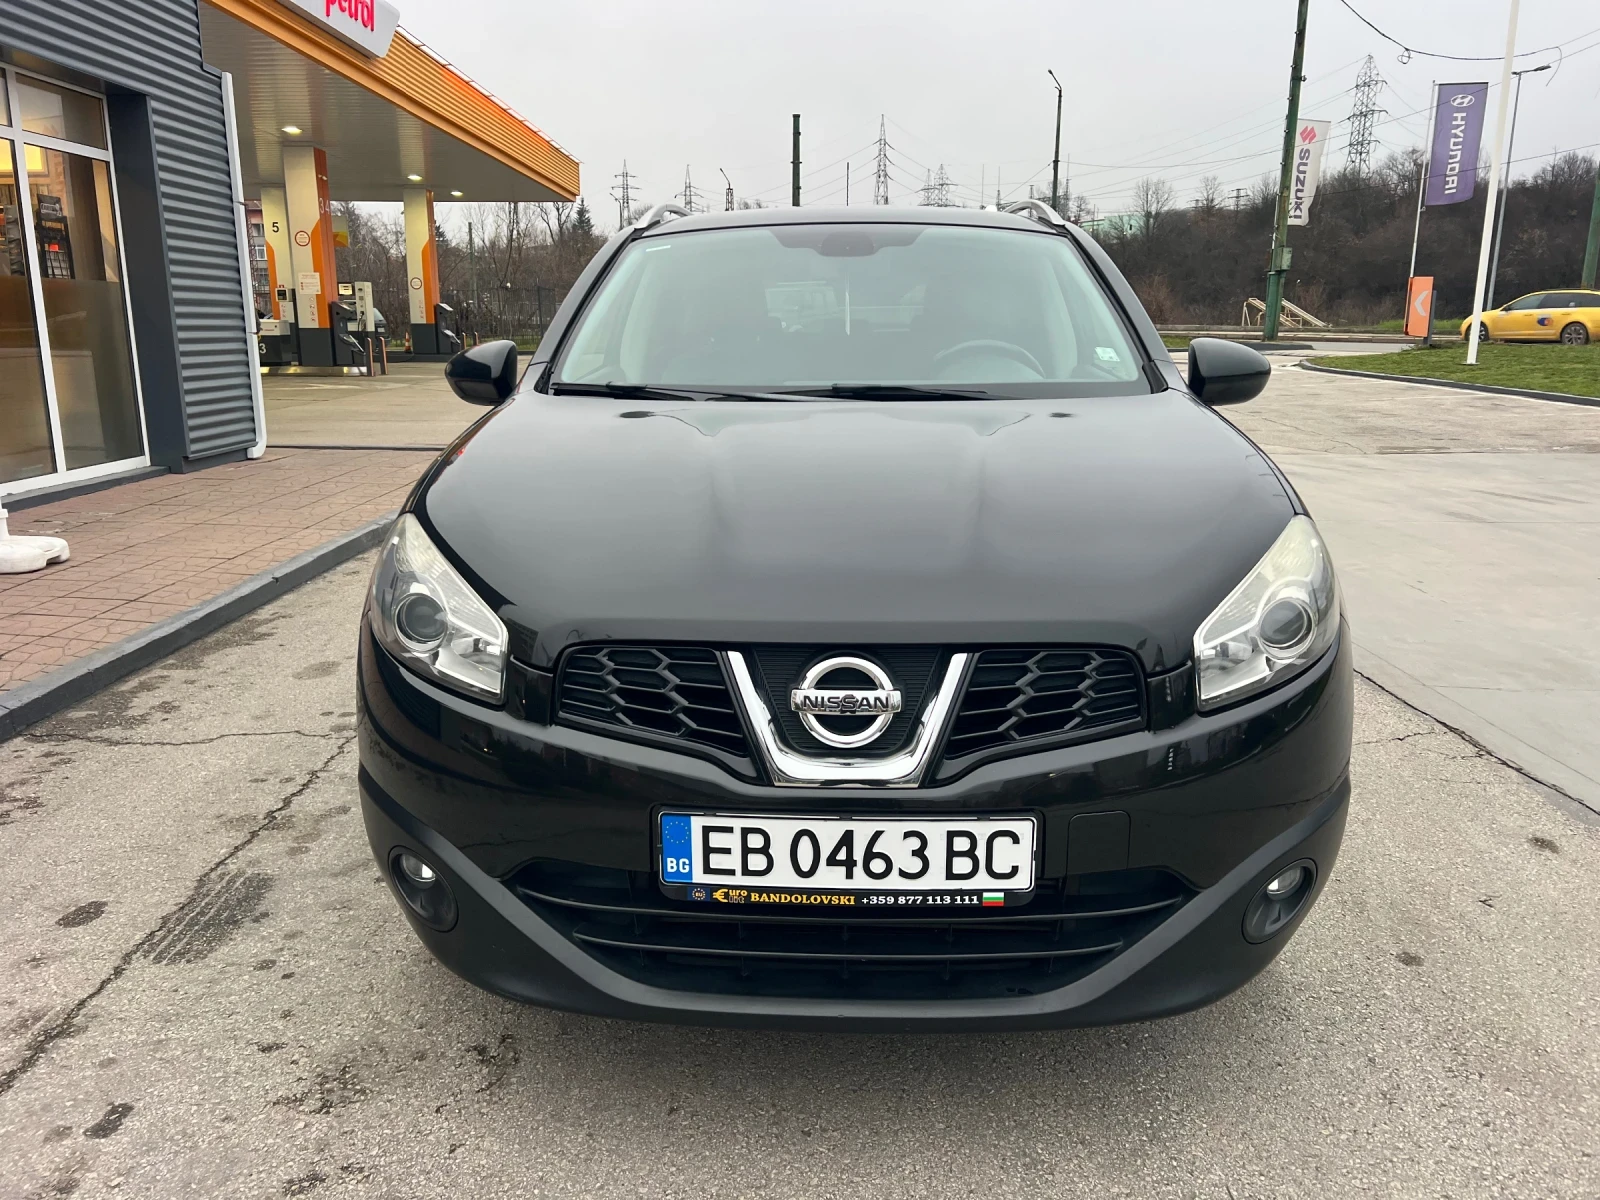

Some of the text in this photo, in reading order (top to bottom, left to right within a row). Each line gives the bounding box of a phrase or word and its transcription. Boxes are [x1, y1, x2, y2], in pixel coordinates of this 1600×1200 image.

[1444, 112, 1467, 194] HYUNDAI
[1293, 147, 1311, 220] SUZUKI
[272, 221, 280, 233] 5
[259, 343, 267, 354] 3
[803, 695, 889, 710] NISSAN
[701, 824, 1021, 881] EB 0463 BC
[666, 857, 690, 873] BG
[750, 892, 979, 905] BANDOLOVSKI +359 877 113 111
